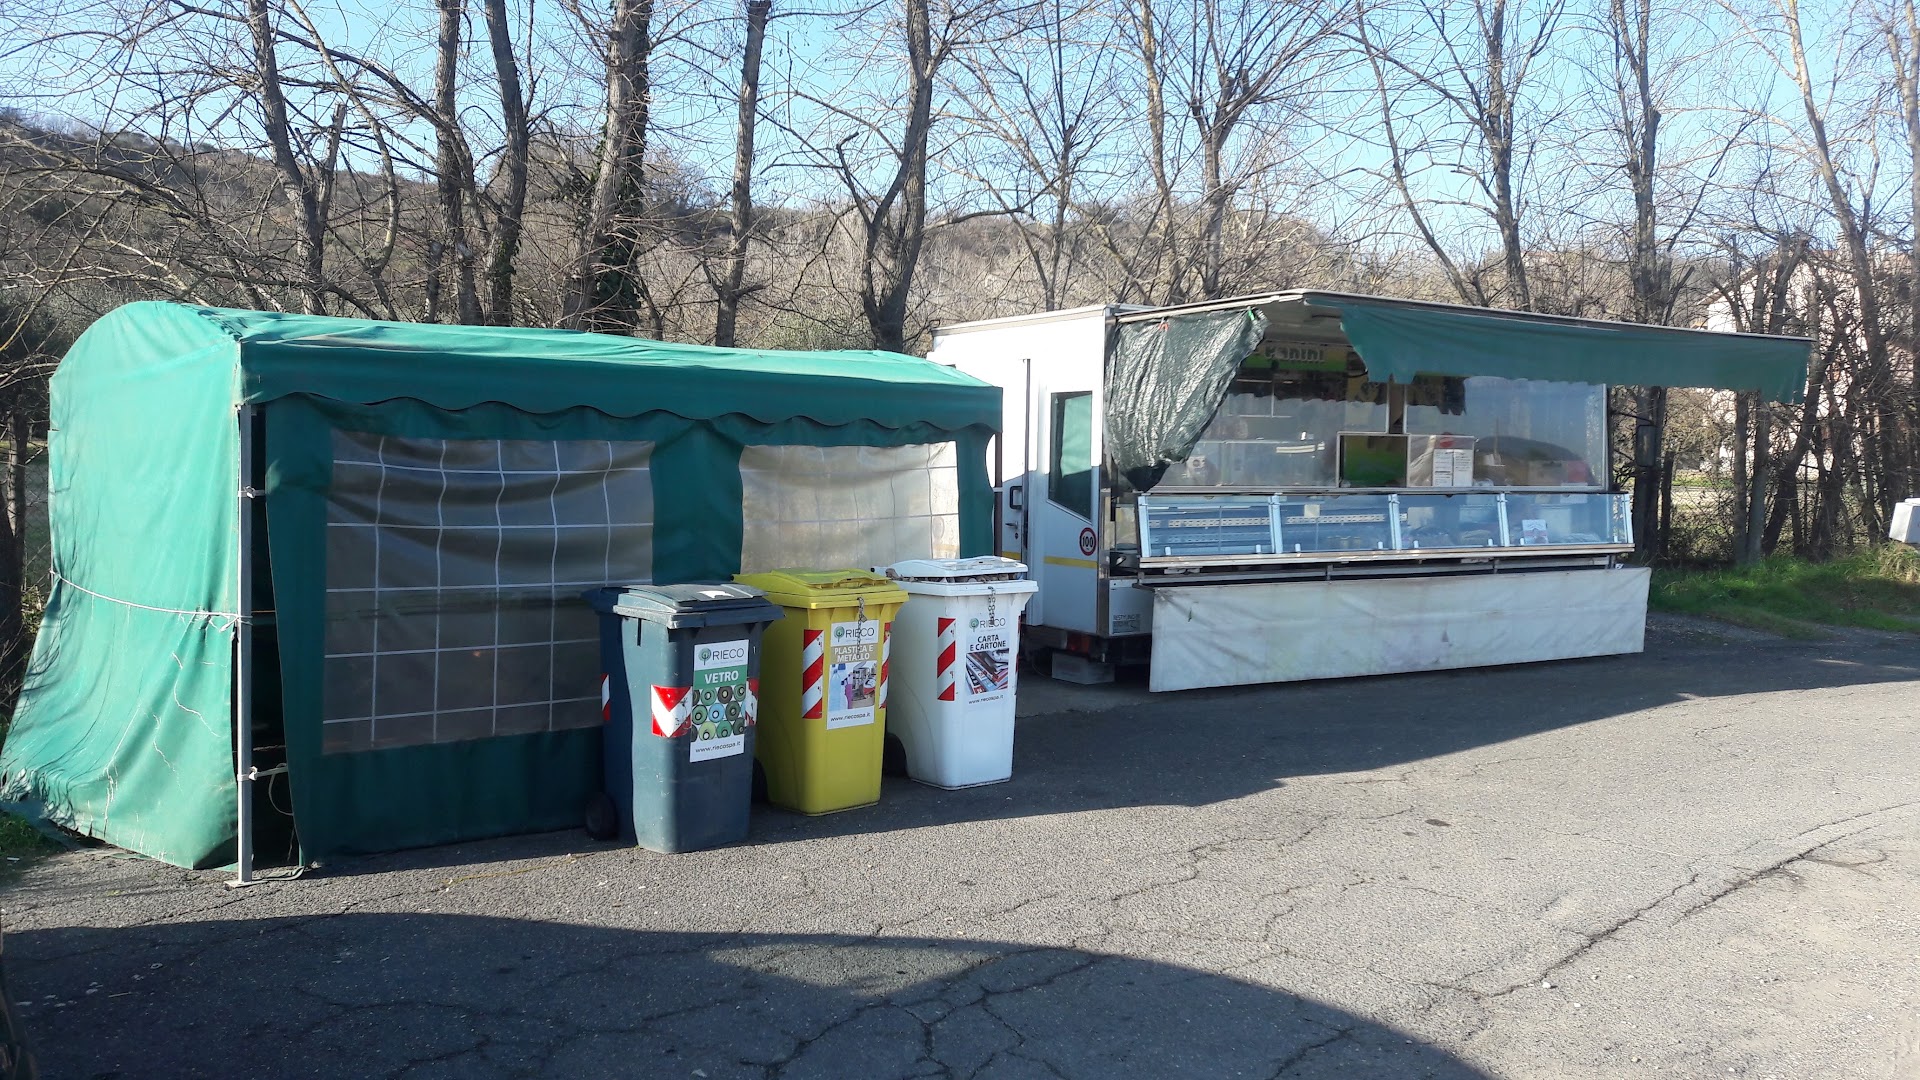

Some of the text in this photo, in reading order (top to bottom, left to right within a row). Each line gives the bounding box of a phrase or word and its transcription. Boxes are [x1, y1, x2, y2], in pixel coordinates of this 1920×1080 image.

[1082, 535, 1094, 548] 100
[845, 627, 875, 639] RIECO
[977, 634, 999, 643] CARTA
[868, 644, 874, 652] E
[975, 640, 1006, 651] CARTONE
[712, 647, 745, 661] RIECO
[704, 671, 739, 684] VETRO
[696, 741, 741, 752] www.riecospa.it
